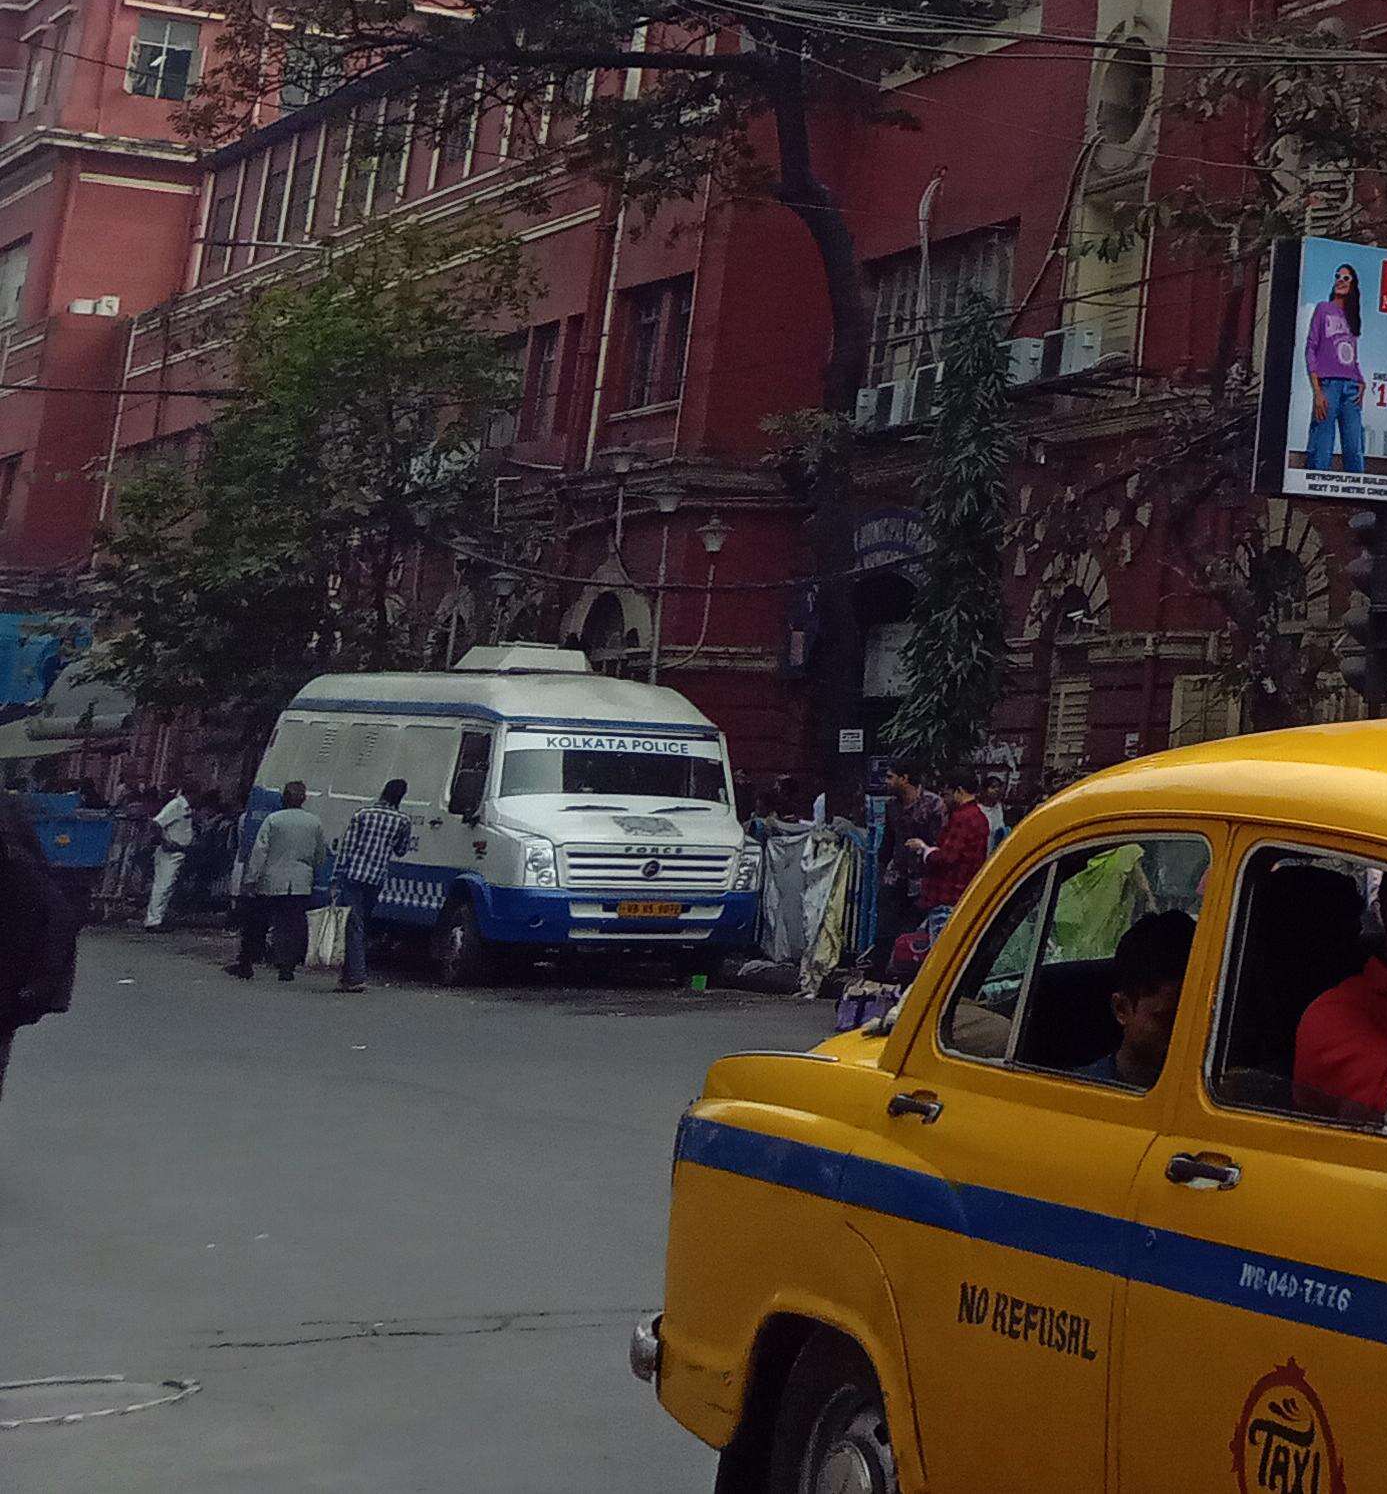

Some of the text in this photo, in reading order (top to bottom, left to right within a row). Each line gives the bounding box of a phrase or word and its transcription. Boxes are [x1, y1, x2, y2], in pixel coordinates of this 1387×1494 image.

[1305, 472, 1361, 484] METROPOLITAN
[1329, 484, 1340, 493] TO
[546, 735, 689, 755] KOLKATA POLICE
[957, 1281, 1098, 1362] NO REFUSAL
[1249, 1417, 1321, 1494] TAXI
